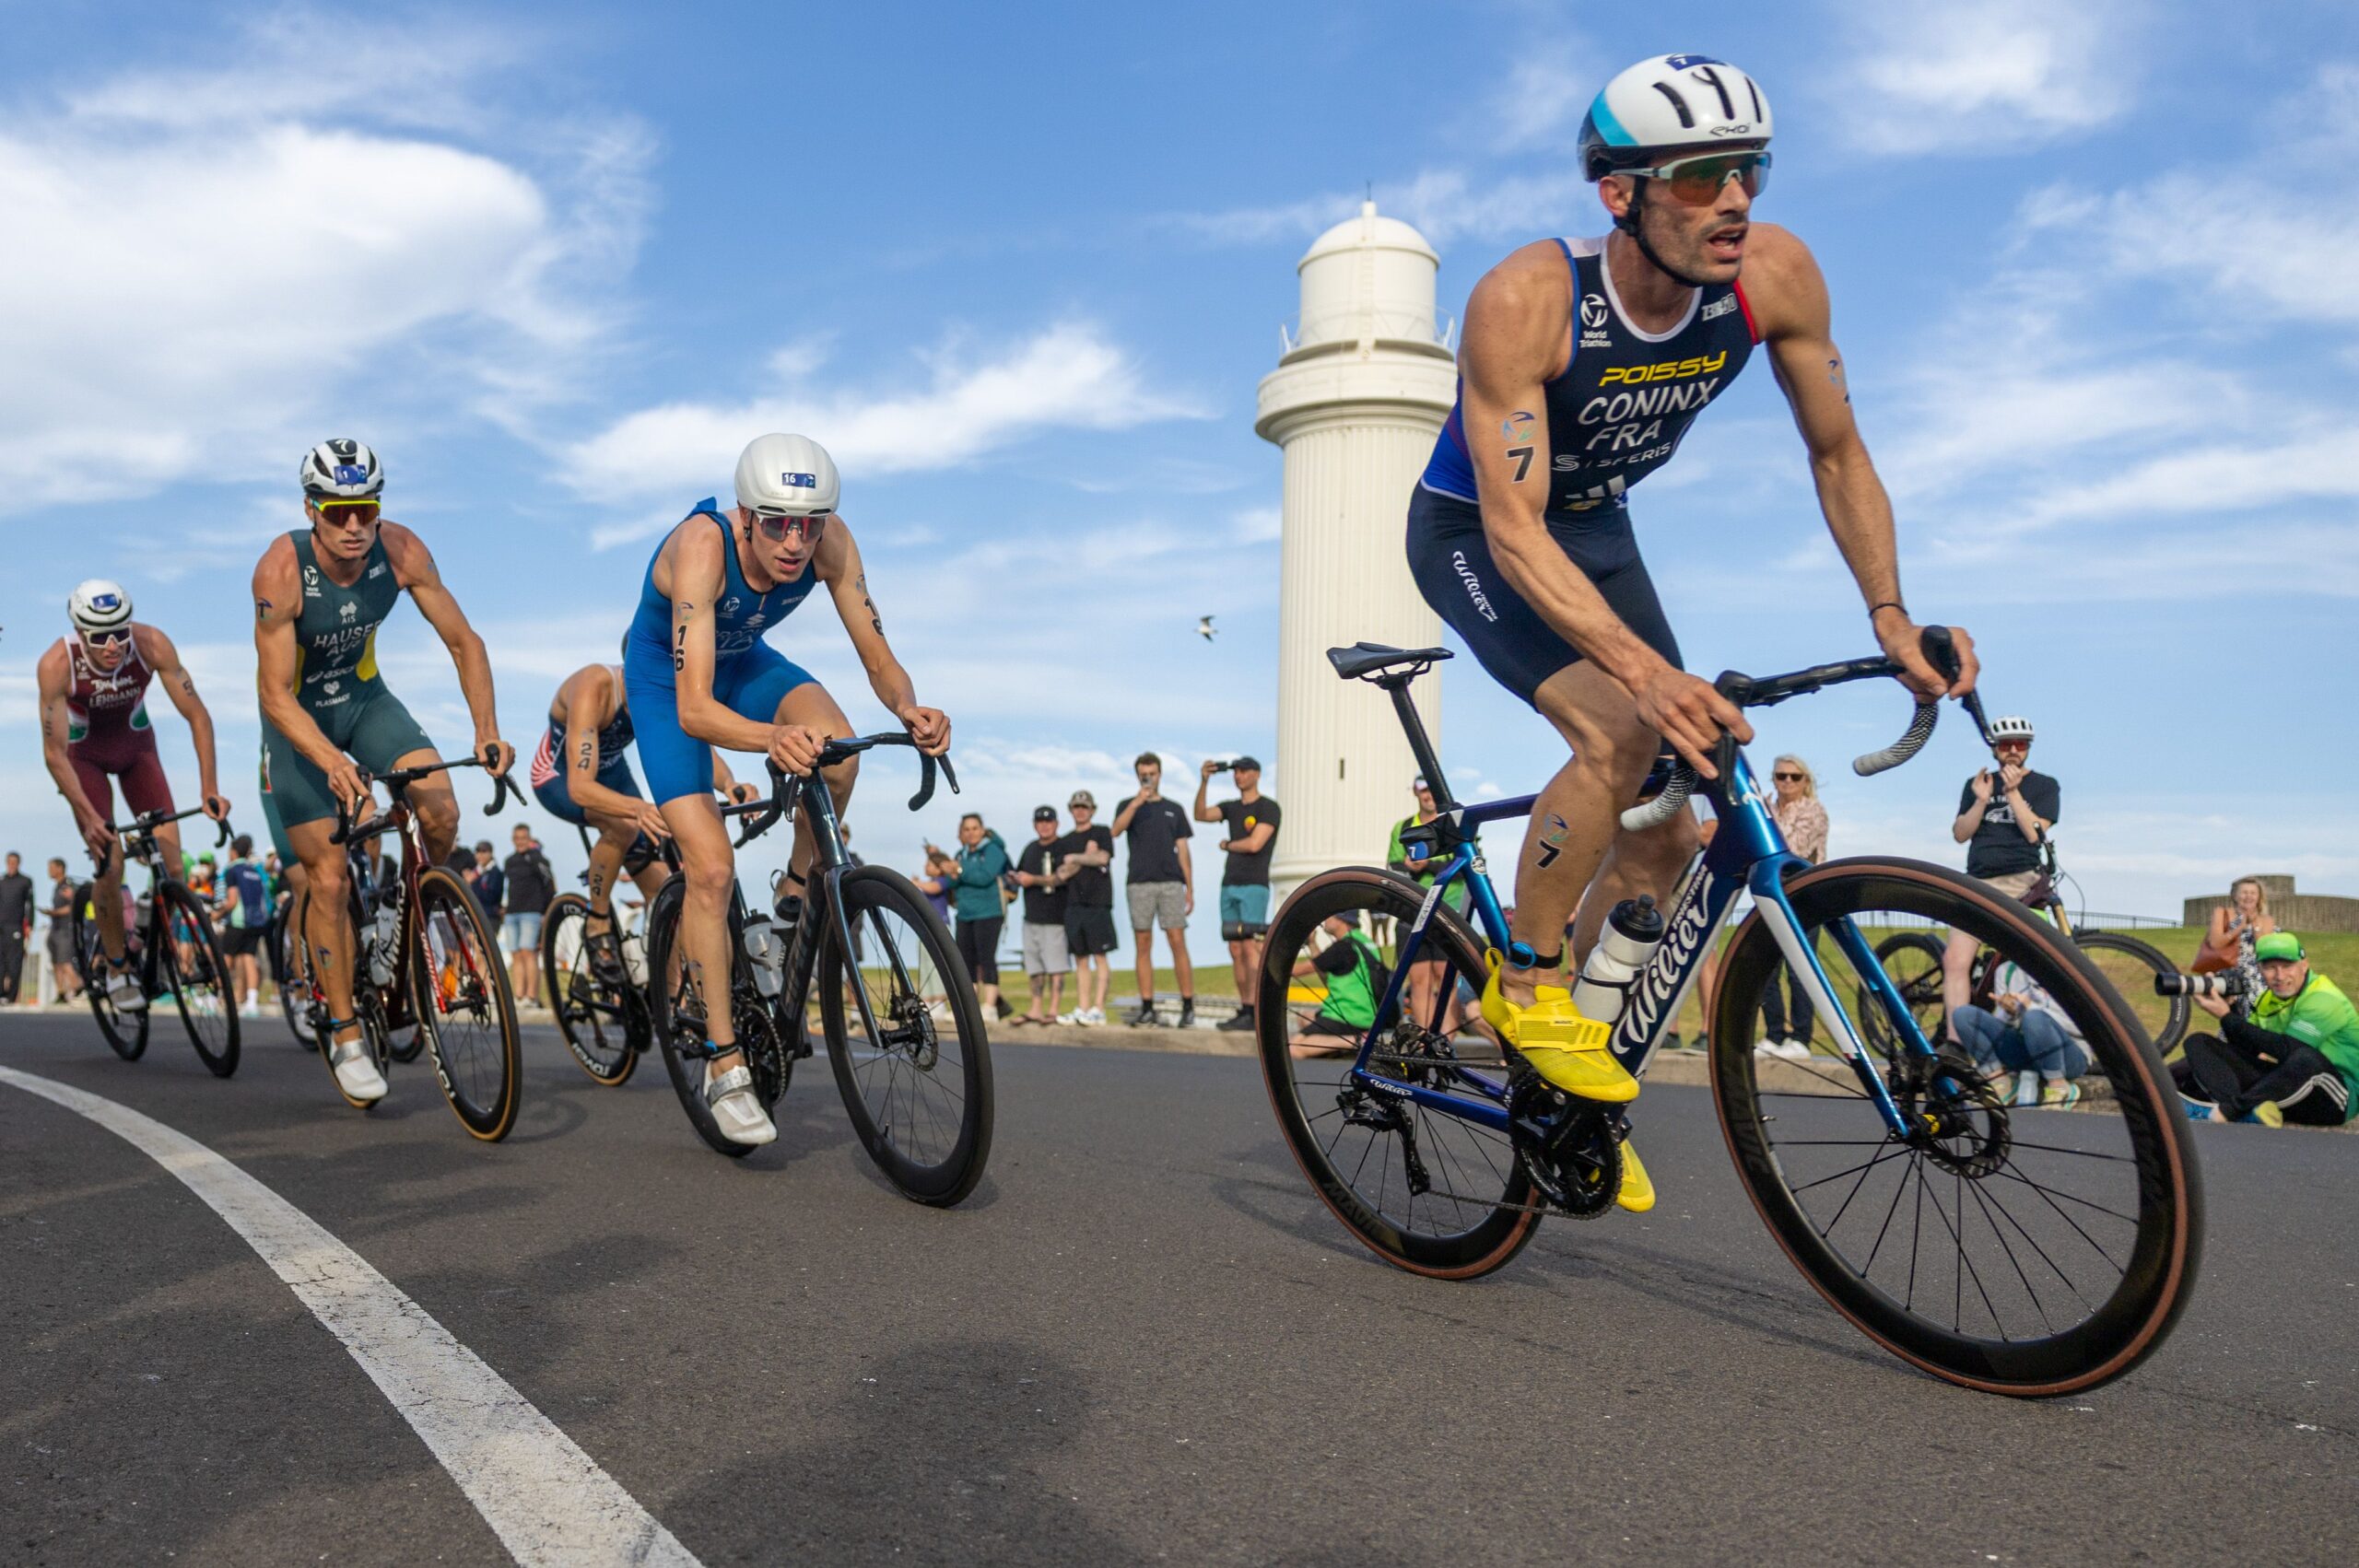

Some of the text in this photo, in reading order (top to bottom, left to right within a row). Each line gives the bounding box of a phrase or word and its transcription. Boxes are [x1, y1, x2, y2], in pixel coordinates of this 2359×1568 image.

[1579, 339, 1612, 348] Triathlon
[1583, 330, 1607, 339] World
[1598, 350, 1728, 387] POISSY
[1577, 377, 1719, 426] CONINX
[1585, 418, 1663, 451] FRA
[783, 474, 796, 484] 16
[1506, 445, 1535, 483] 7
[342, 615, 357, 625] AIS
[1408, 846, 1417, 859] 7
[1536, 837, 1562, 869] 7
[1612, 871, 1716, 1055] Wilier
